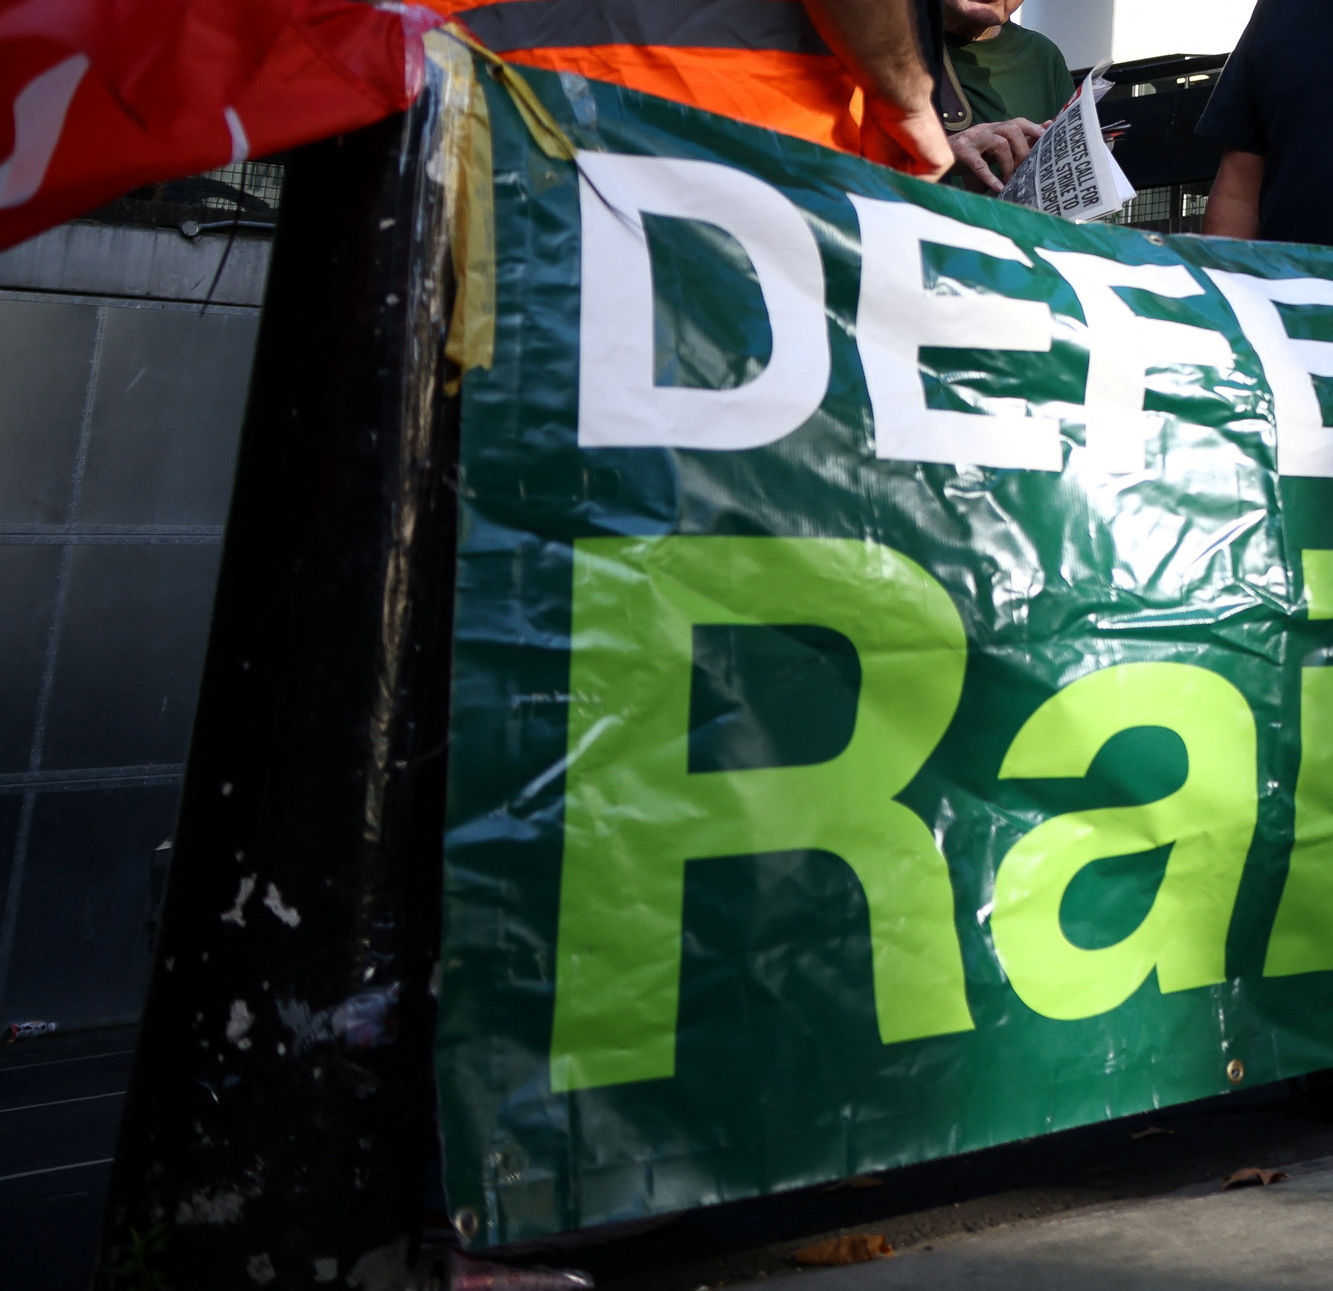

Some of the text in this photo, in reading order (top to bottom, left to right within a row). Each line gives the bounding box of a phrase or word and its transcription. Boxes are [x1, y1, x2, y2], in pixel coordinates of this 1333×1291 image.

[1053, 126, 1070, 165] GENERAL
[1068, 123, 1089, 161] PICKETS
[1040, 164, 1055, 184] PAY
[1056, 162, 1077, 197] STRIKE
[1075, 160, 1094, 187] CALL
[1062, 194, 1080, 211] TO
[1079, 185, 1100, 208] FOR
